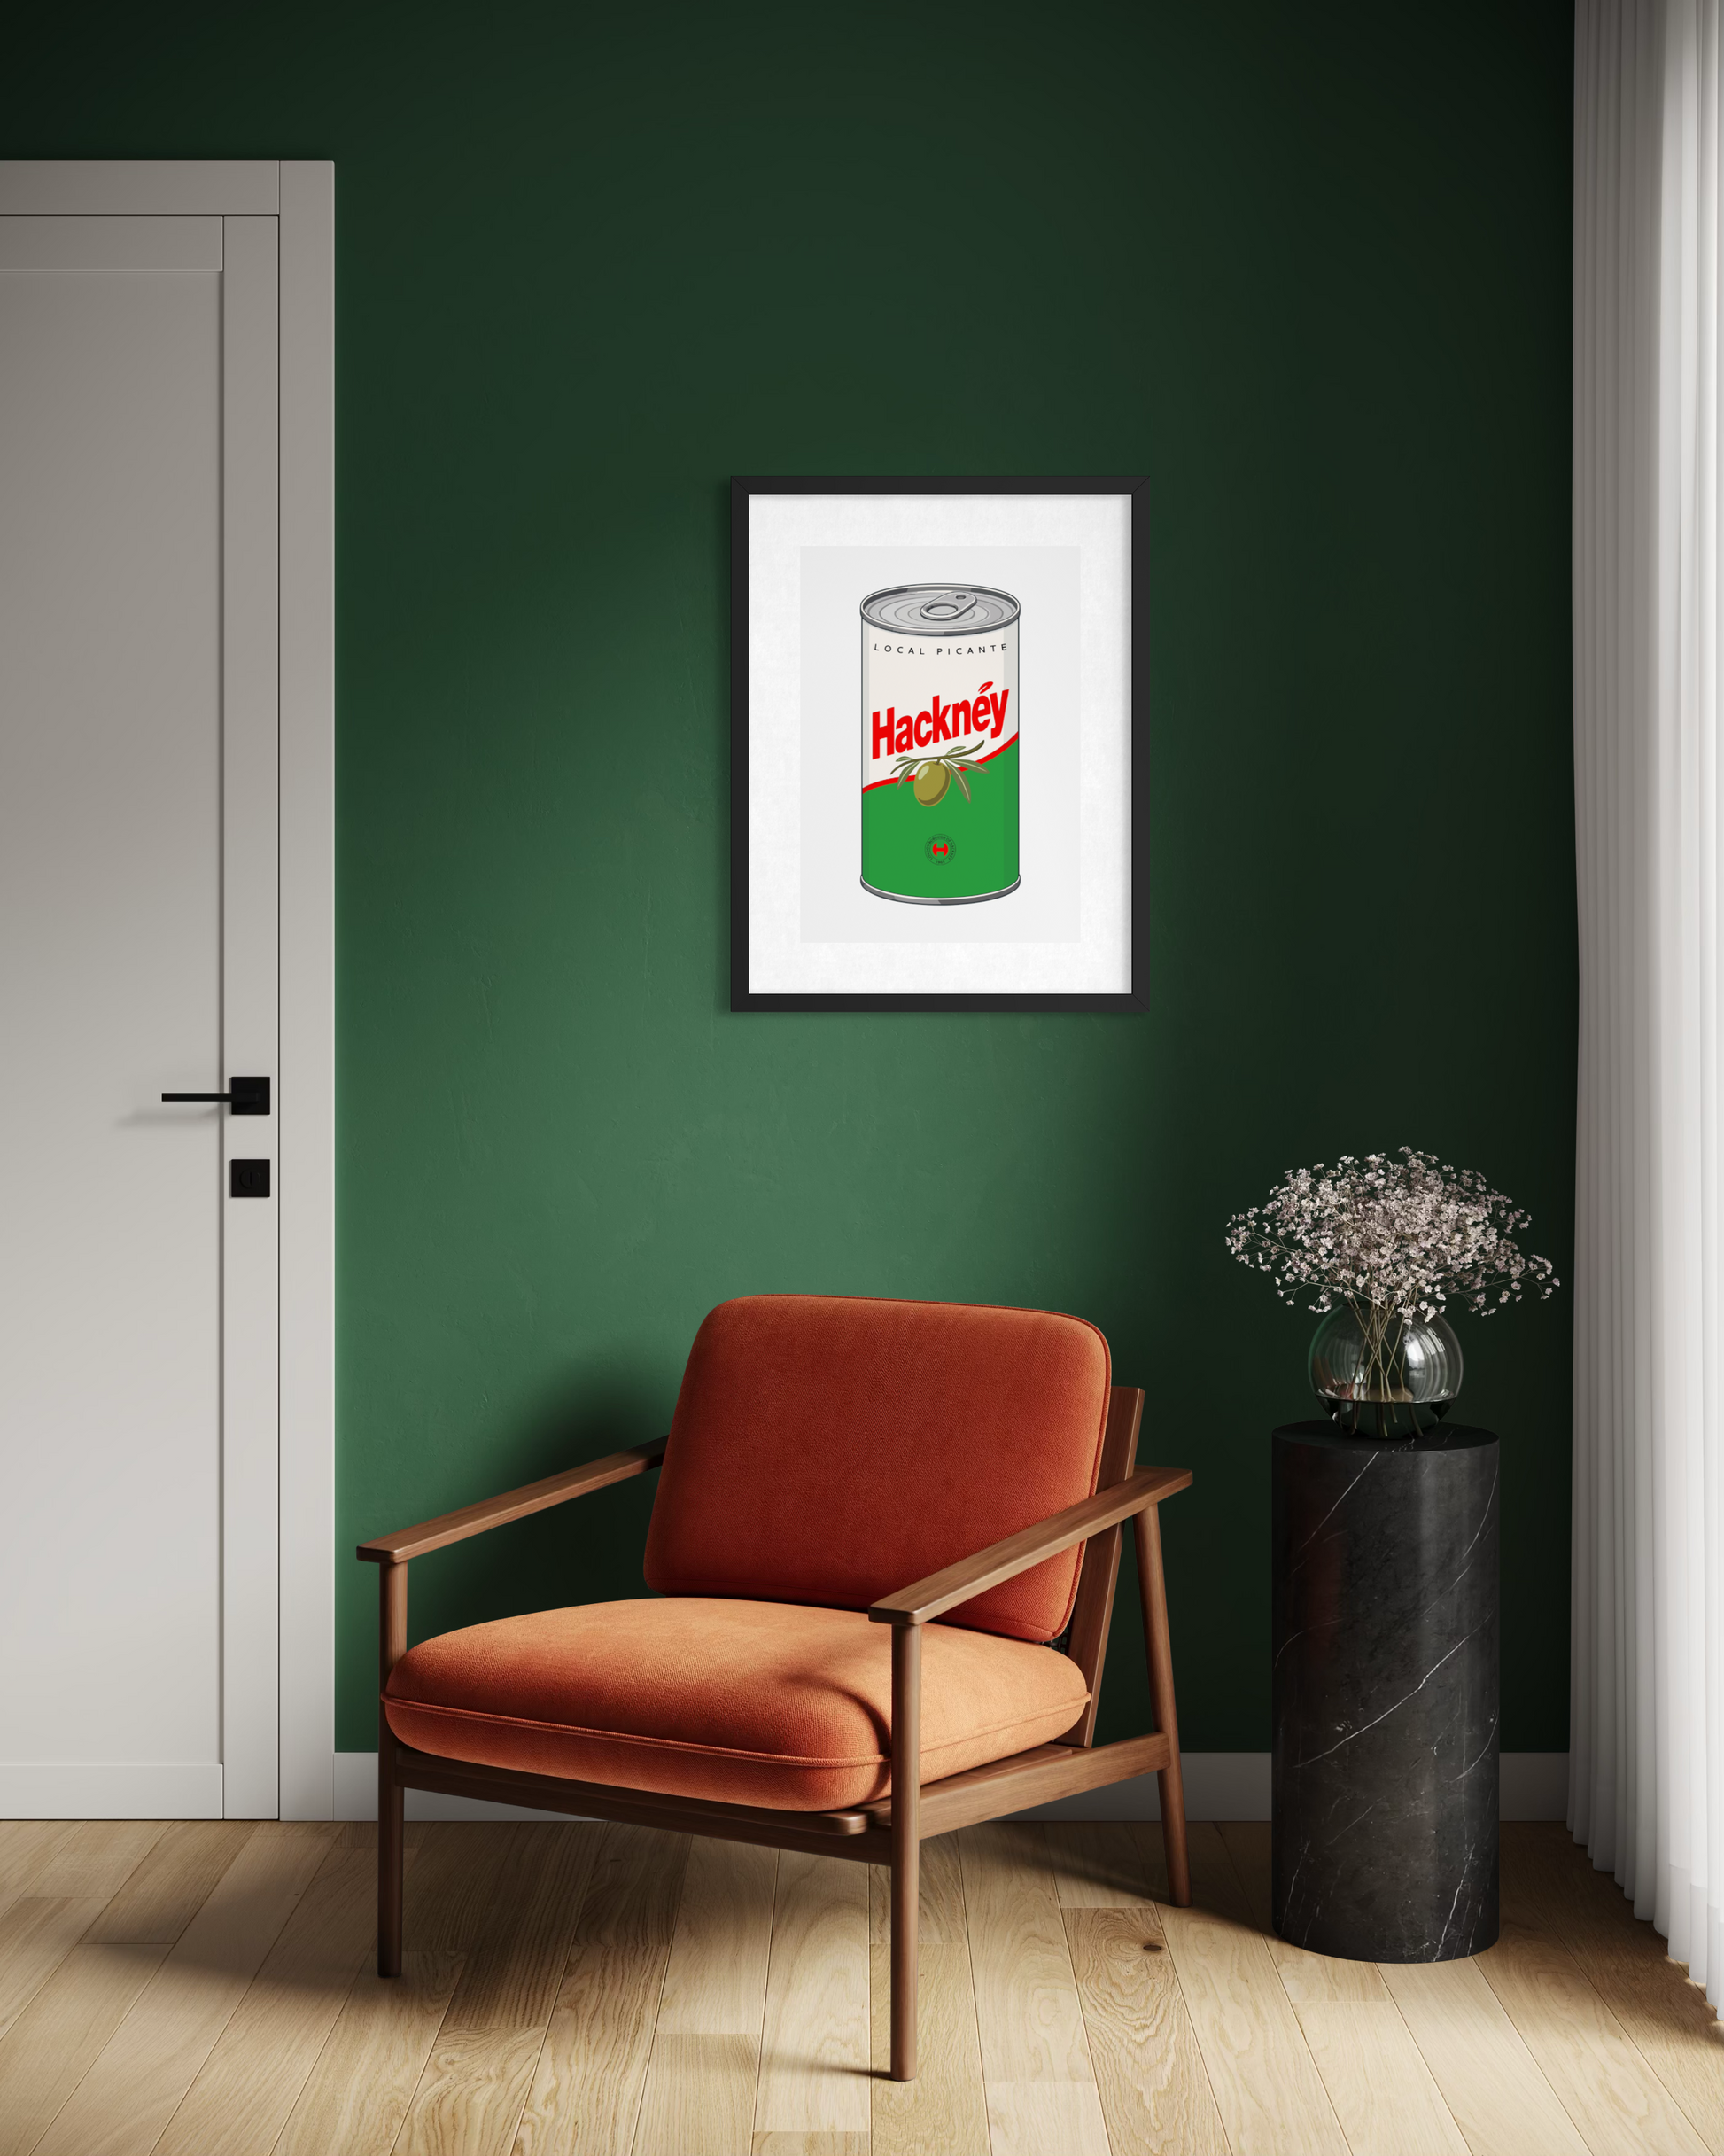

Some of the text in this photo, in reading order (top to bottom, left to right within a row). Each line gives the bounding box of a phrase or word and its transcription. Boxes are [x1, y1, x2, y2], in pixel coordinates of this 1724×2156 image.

[874, 643, 1007, 655] LOCAL PICANTE
[872, 681, 1009, 759] Hacknéy
